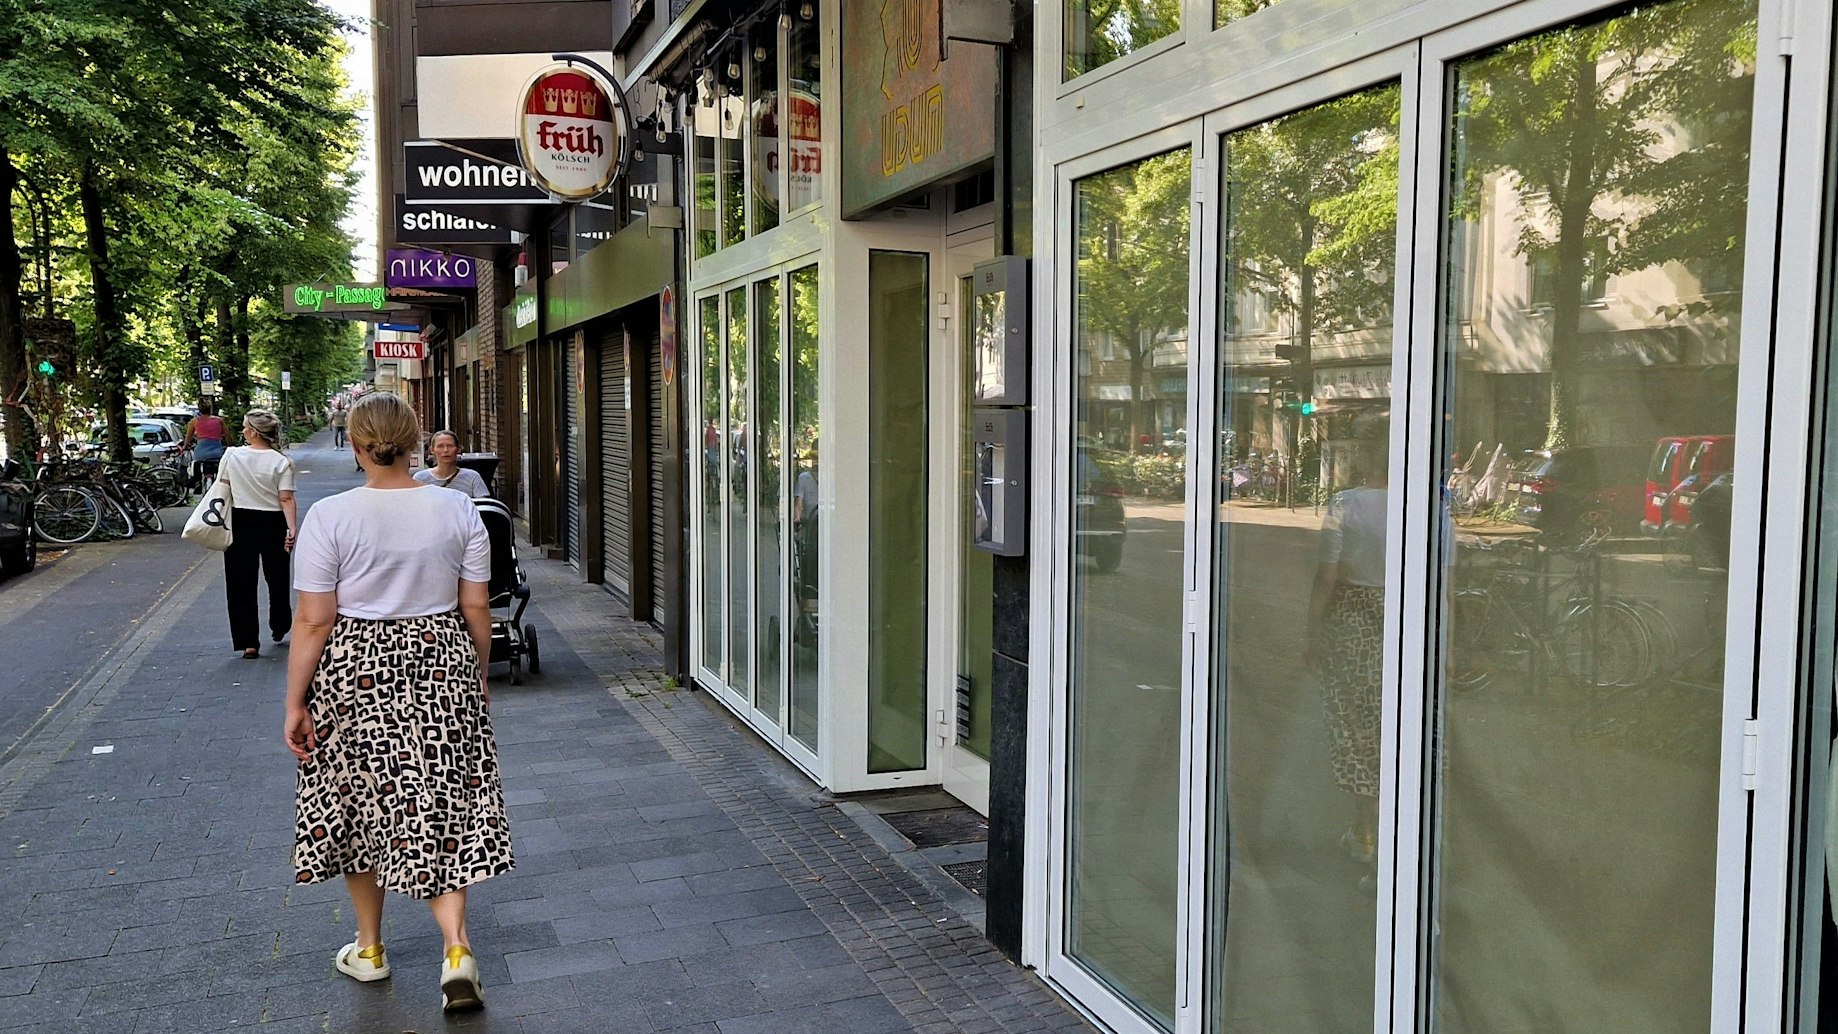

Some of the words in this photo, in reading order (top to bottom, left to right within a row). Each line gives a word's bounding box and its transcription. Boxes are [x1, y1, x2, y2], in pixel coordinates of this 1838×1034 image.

[536, 120, 604, 158] früh
[551, 153, 590, 164] KÖLSCH
[294, 285, 324, 311] City
[335, 284, 386, 310] Passag
[380, 343, 418, 357] KIOSK
